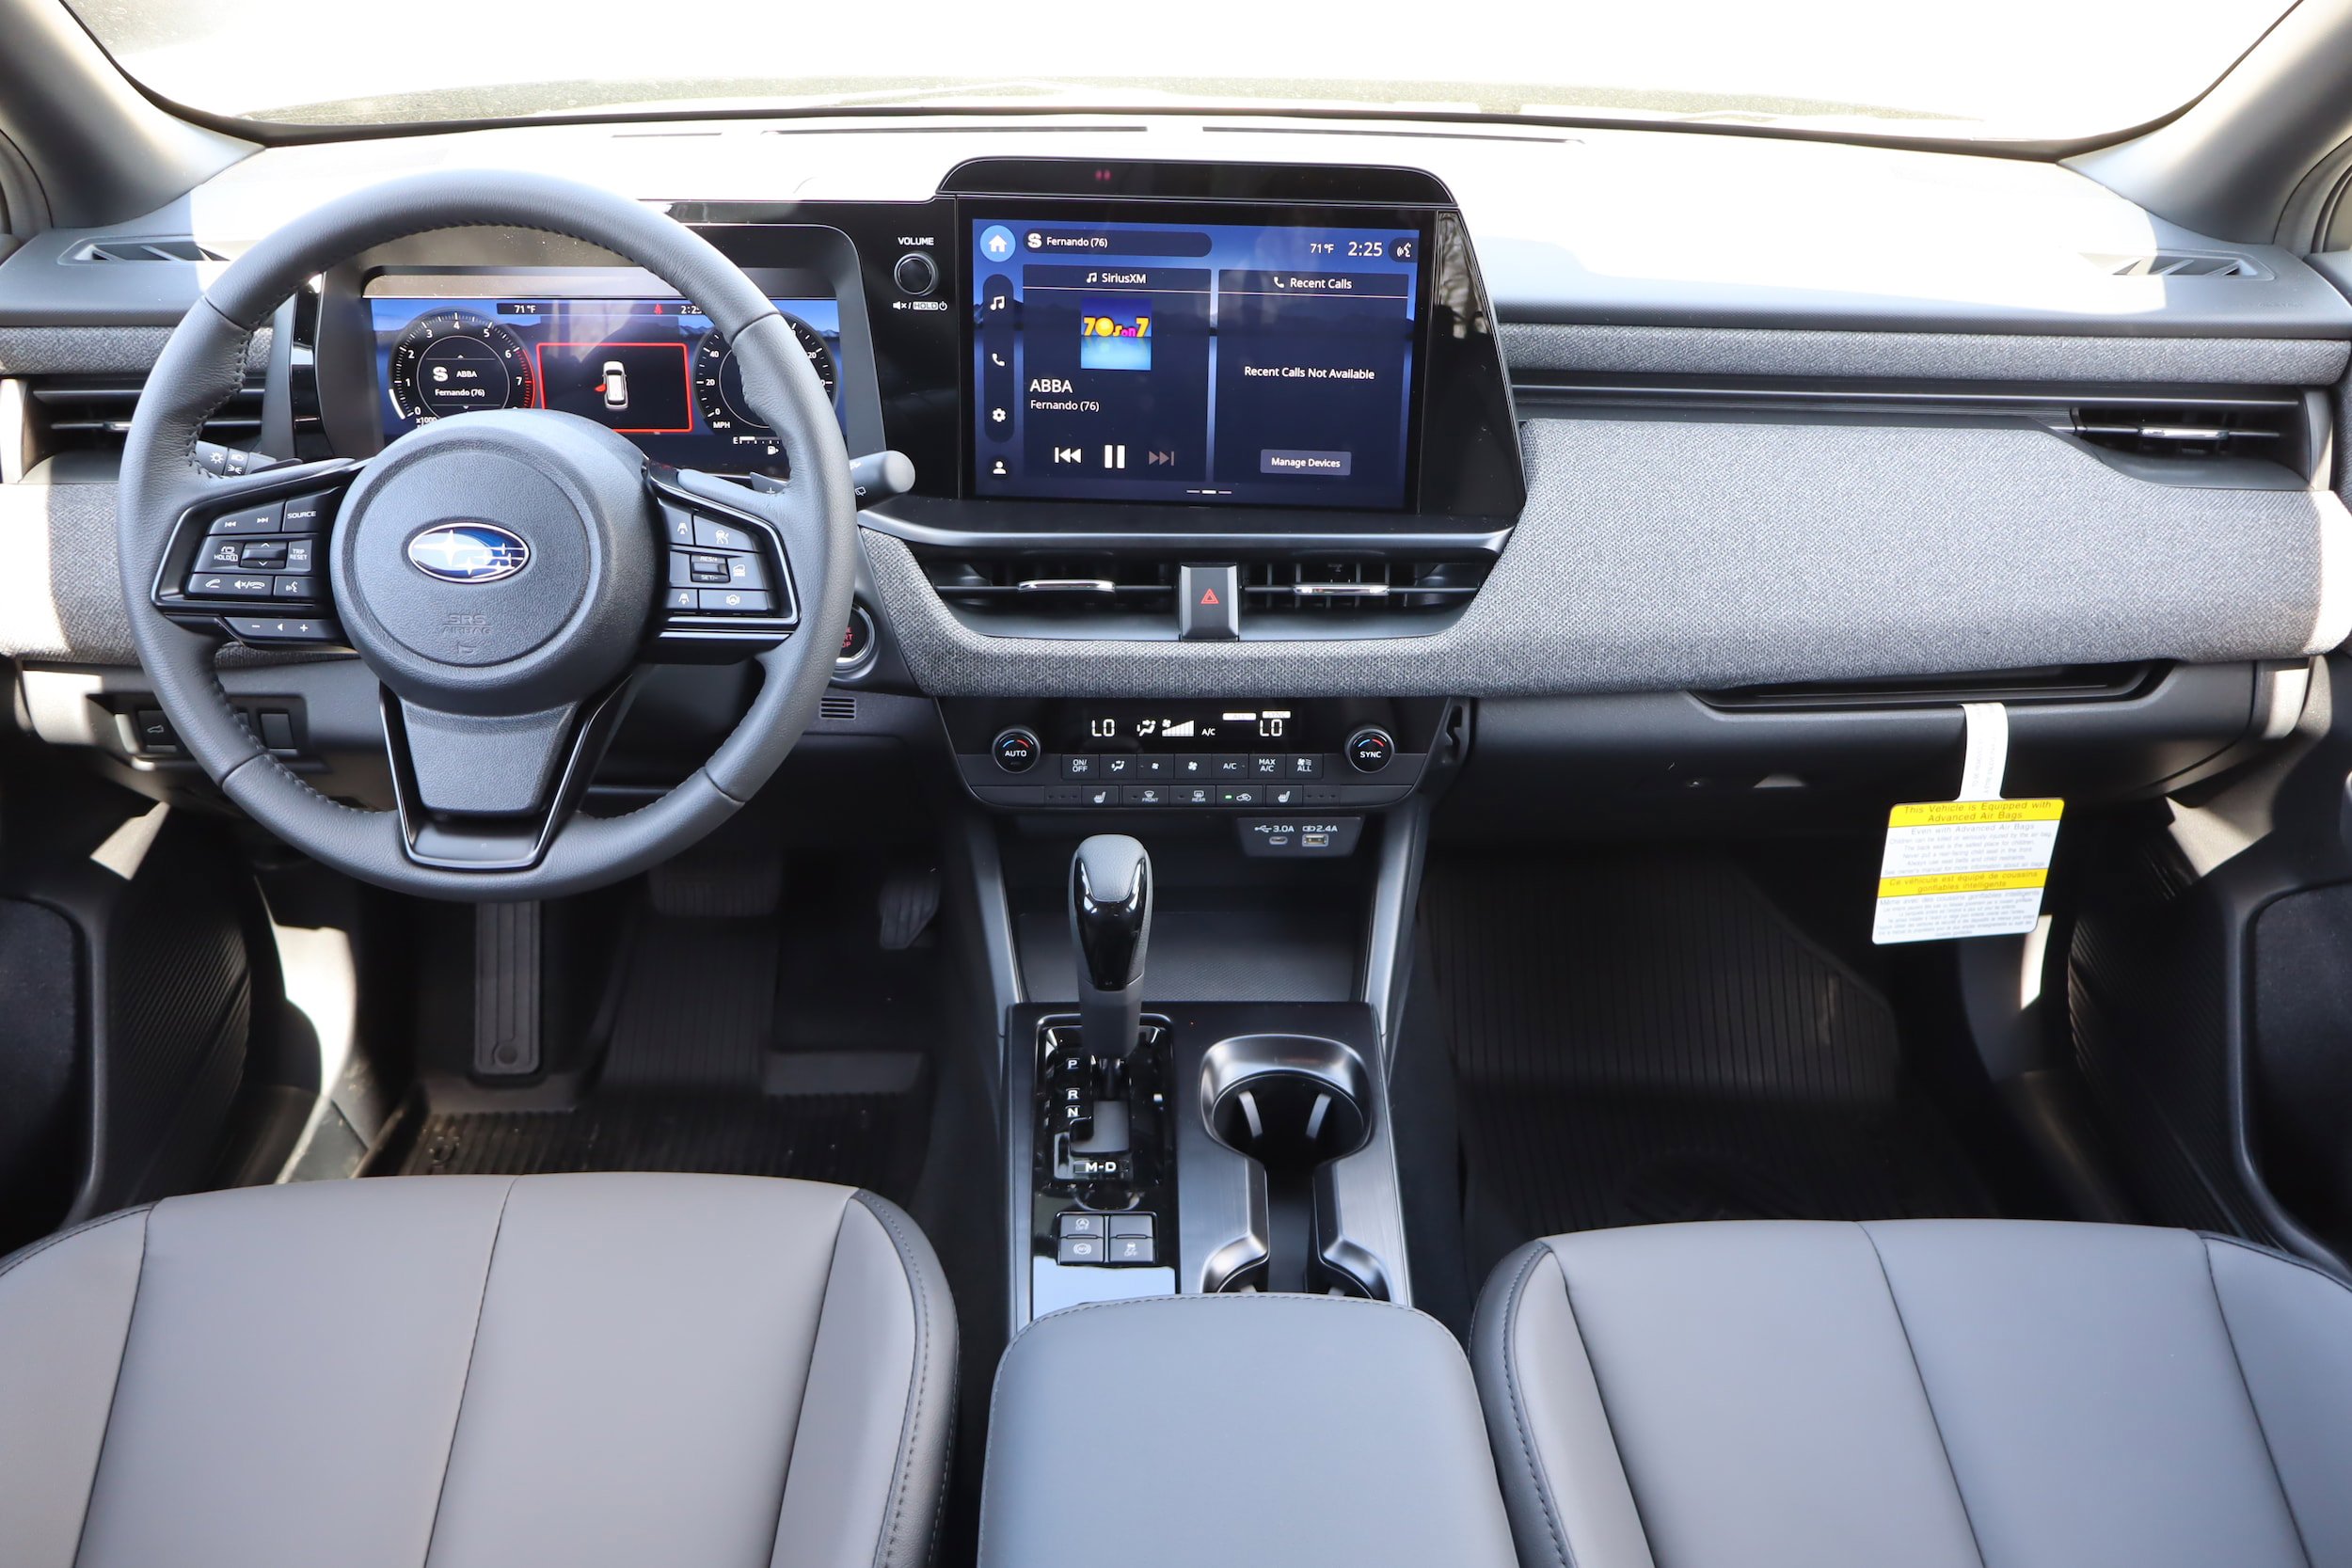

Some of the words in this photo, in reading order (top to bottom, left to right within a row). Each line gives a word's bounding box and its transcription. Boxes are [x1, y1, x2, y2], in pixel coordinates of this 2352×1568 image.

[898, 237, 934, 245] VOLUME
[1046, 236, 1089, 247] Fernando
[1090, 237, 1108, 248] (76)
[1348, 241, 1383, 257] 2:25
[1102, 272, 1147, 285] SiriusXM
[1290, 277, 1324, 289] Recent
[1327, 277, 1353, 290] Calls
[453, 321, 460, 330] 4
[1120, 326, 1136, 338] on
[1136, 317, 1150, 338] 7
[426, 329, 434, 339] 3
[483, 329, 490, 339] 5
[407, 350, 416, 359] 2
[504, 349, 512, 358] 6
[710, 351, 720, 359] 40
[1245, 366, 1279, 379] Recent
[1280, 367, 1306, 379] Calls
[1308, 368, 1325, 380] Not
[1327, 368, 1375, 380] Available
[405, 378, 411, 387] 1
[516, 376, 523, 386] 7
[706, 378, 716, 387] 20
[1029, 378, 1073, 394] ABBA
[435, 388, 470, 397] Fernando
[471, 388, 485, 398] (76)
[414, 407, 421, 416] 0
[714, 407, 721, 416] 0
[1030, 400, 1078, 411] Fernando
[1079, 400, 1100, 413] (76)
[713, 420, 731, 429] MPH
[1271, 456, 1305, 469] Manage
[1306, 457, 1341, 469] Devices
[287, 510, 317, 519] SOURCE
[449, 613, 487, 626] SRS
[443, 626, 491, 635] AIRBAG
[1201, 728, 1216, 736] A/C
[1359, 751, 1382, 759] SYNC
[1223, 762, 1237, 770] A/C
[1904, 804, 1925, 814] This
[1929, 803, 1964, 813] Vehicle
[1969, 802, 1977, 811] is
[1981, 802, 2027, 812] Equipped
[2032, 800, 2052, 809] with
[1928, 813, 1977, 822] Advanced
[1980, 812, 1994, 820] Air
[1997, 811, 2023, 821] Bags
[1316, 825, 1339, 833] 2.4A
[1935, 826, 1952, 834] with
[1955, 824, 1995, 833] Advanced
[2013, 823, 2035, 832] Bags
[1889, 878, 1901, 886] Ce
[1904, 876, 1939, 885] véhicule
[1957, 873, 1985, 882] équipé
[1917, 883, 1959, 894] gonflables
[1068, 1059, 1078, 1069] P
[1067, 1089, 1079, 1100] R
[1068, 1107, 1079, 1117] N
